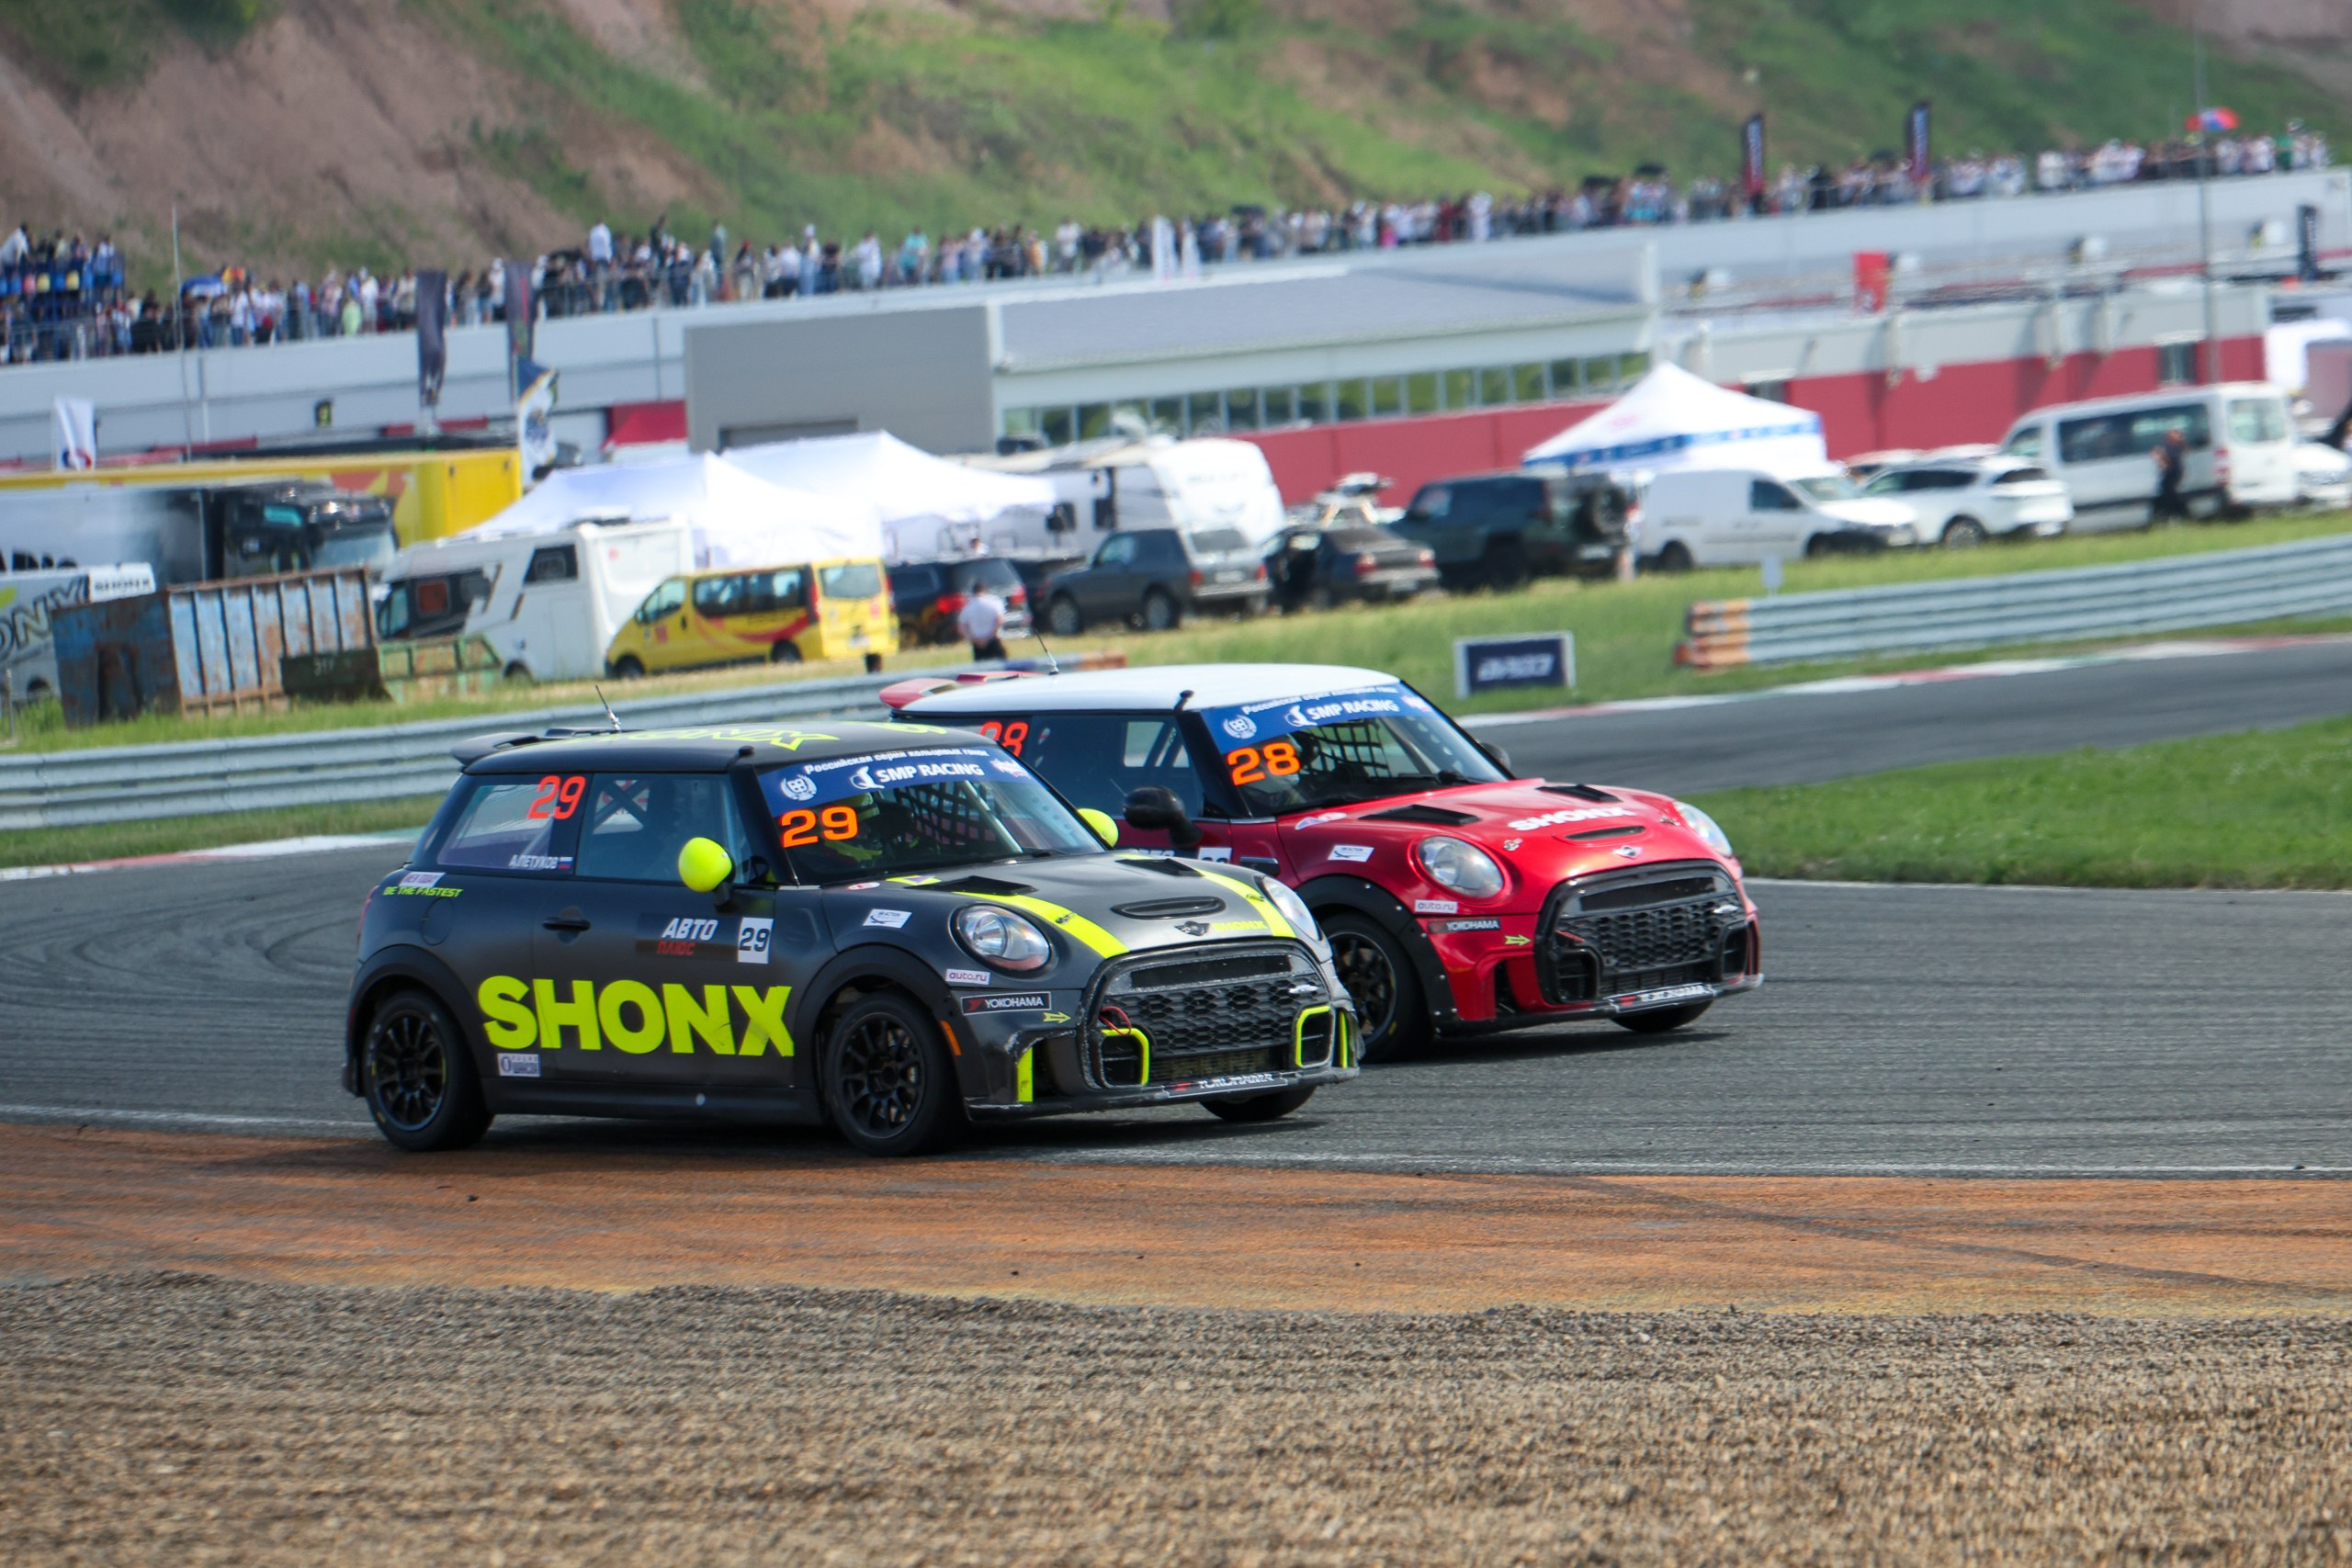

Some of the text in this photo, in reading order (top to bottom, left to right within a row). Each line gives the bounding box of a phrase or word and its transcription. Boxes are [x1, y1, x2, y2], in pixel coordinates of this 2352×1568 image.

[1306, 703, 1342, 720] SMP
[1342, 699, 1400, 713] RACING
[804, 754, 873, 774] Российская
[875, 765, 917, 783] SMP
[917, 763, 985, 777] RACING
[1227, 742, 1301, 785] 28
[526, 775, 586, 819] 29
[781, 806, 858, 848] 29
[1508, 807, 1637, 831] SHONX
[383, 886, 463, 897] BE THE FASTEST
[1418, 902, 1454, 911] auto.ru
[662, 918, 718, 941] АВТО
[1446, 919, 1499, 931] YOKOHAMA
[656, 940, 695, 955] ПЛЮС
[738, 927, 770, 953] 29
[949, 971, 987, 982] auto.ru
[985, 996, 1044, 1009] YOKOHAMA
[478, 976, 795, 1057] SHONX
